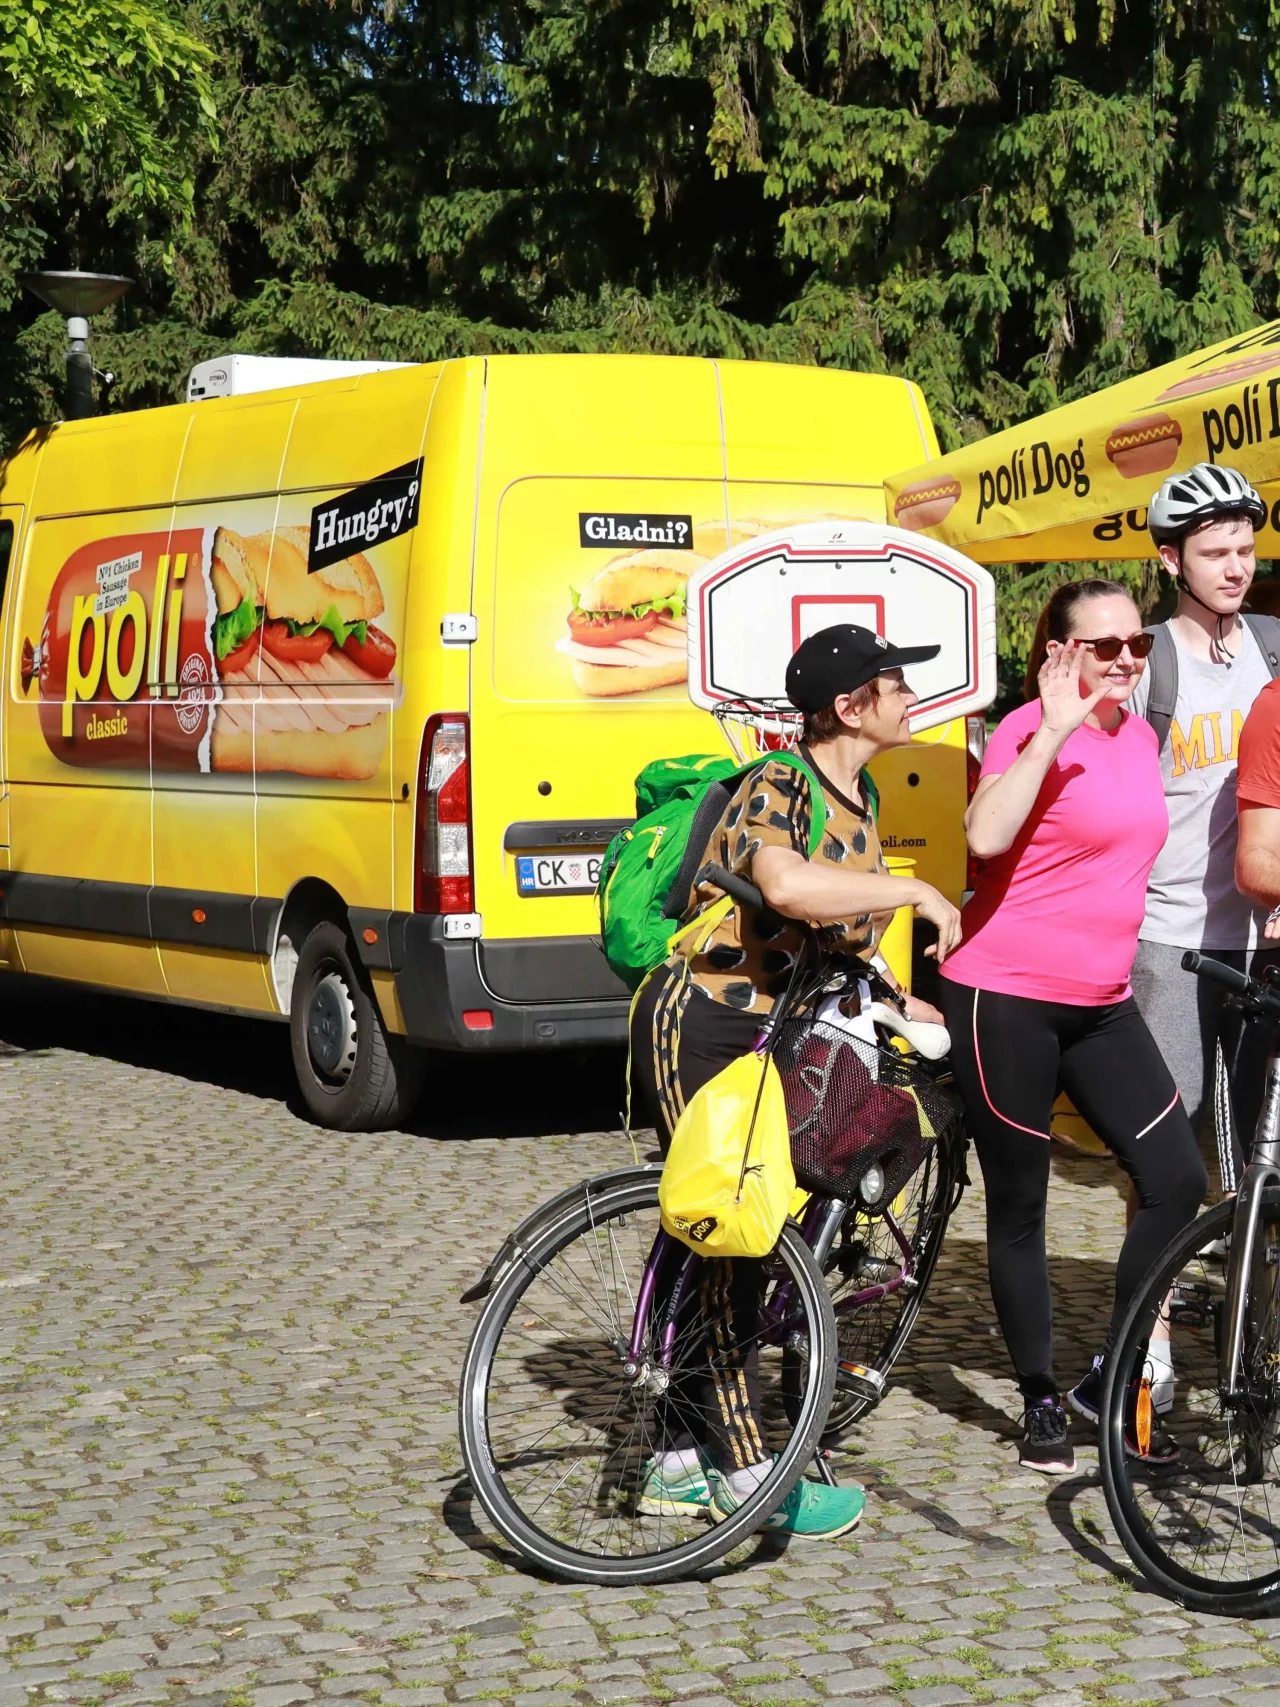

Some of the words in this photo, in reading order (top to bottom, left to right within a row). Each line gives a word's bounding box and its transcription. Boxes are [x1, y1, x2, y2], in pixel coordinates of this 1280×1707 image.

[1202, 383, 1262, 464] poli
[976, 447, 1027, 525] poli
[1030, 438, 1090, 498] Dog
[314, 479, 419, 552] Hungry?
[585, 516, 689, 544] Gladni?
[113, 558, 139, 576] Chicken
[101, 577, 128, 595] Sausage
[96, 599, 103, 611] in
[104, 593, 127, 608] Europe
[62, 553, 188, 737] poli
[86, 709, 128, 740] classic
[521, 877, 535, 886] HR
[537, 859, 568, 886] ČK
[692, 1220, 711, 1241] porr
